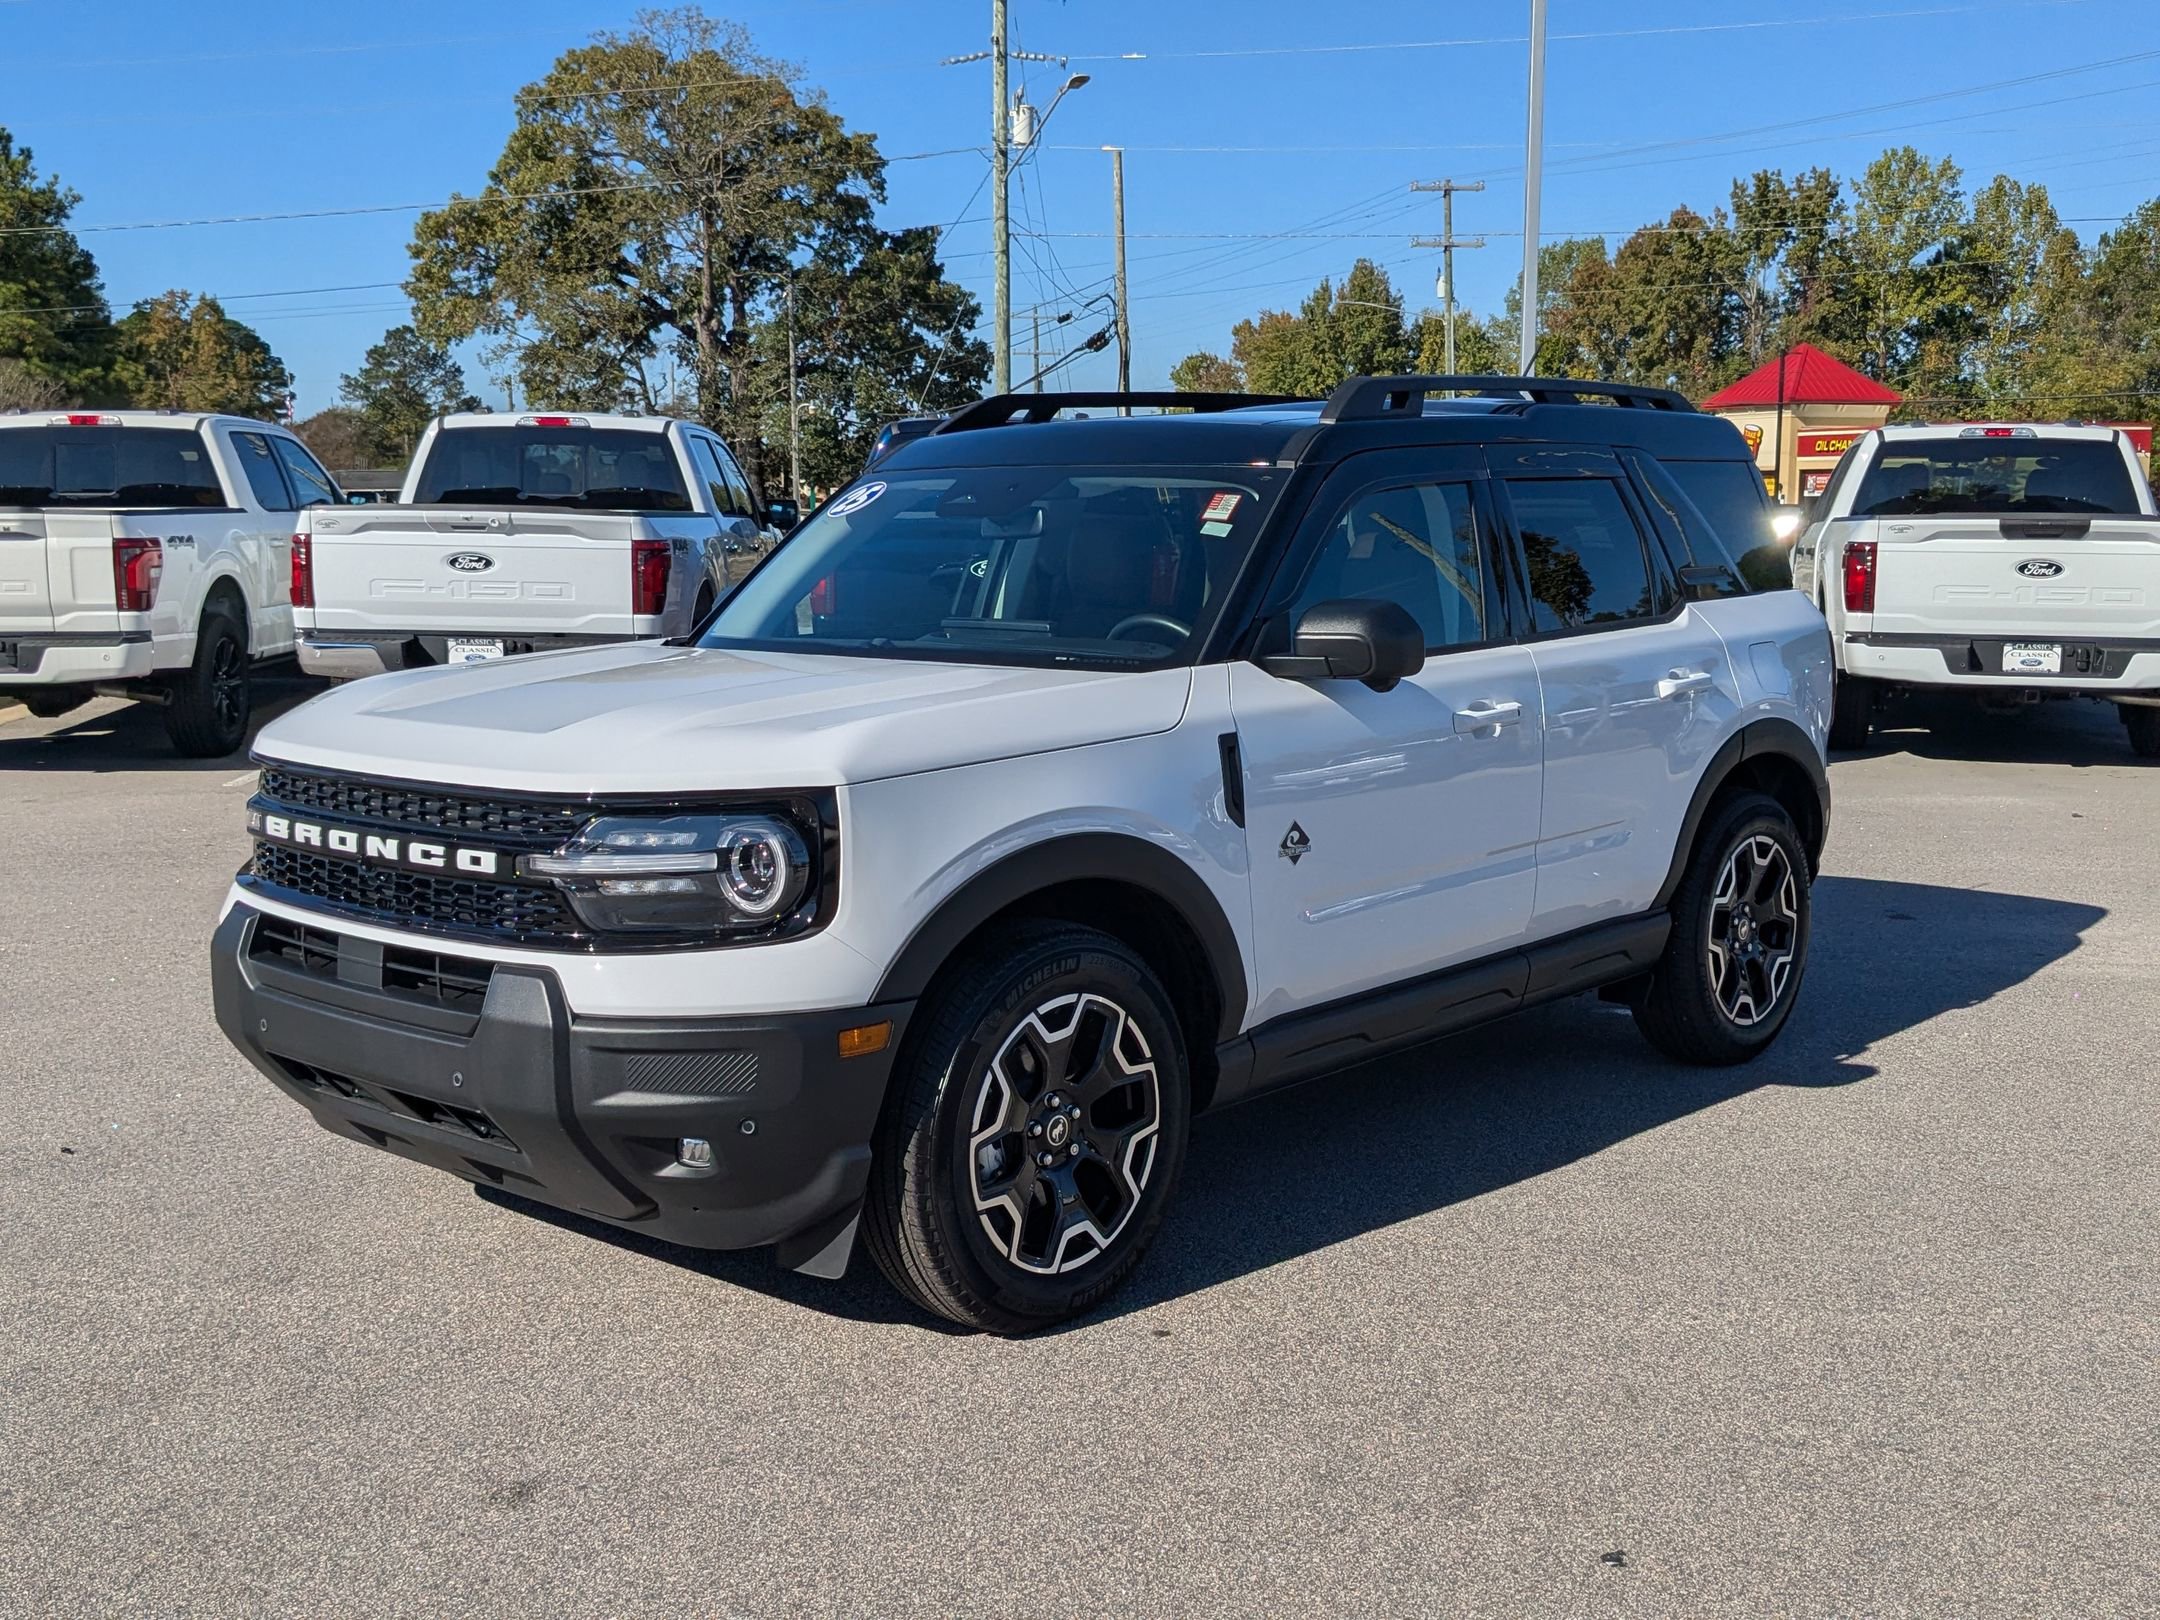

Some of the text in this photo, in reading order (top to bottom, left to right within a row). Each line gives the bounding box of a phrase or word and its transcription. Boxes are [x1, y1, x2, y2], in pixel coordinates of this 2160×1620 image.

[1815, 440, 1828, 451] OIL
[455, 556, 486, 569] Ford
[2024, 563, 2056, 576] Ford
[370, 578, 575, 600] F-150
[1933, 584, 2144, 606] F-150
[458, 638, 494, 646] CLASSIC
[266, 815, 497, 874] BRONCO
[1006, 957, 1078, 1010] MICHELIN
